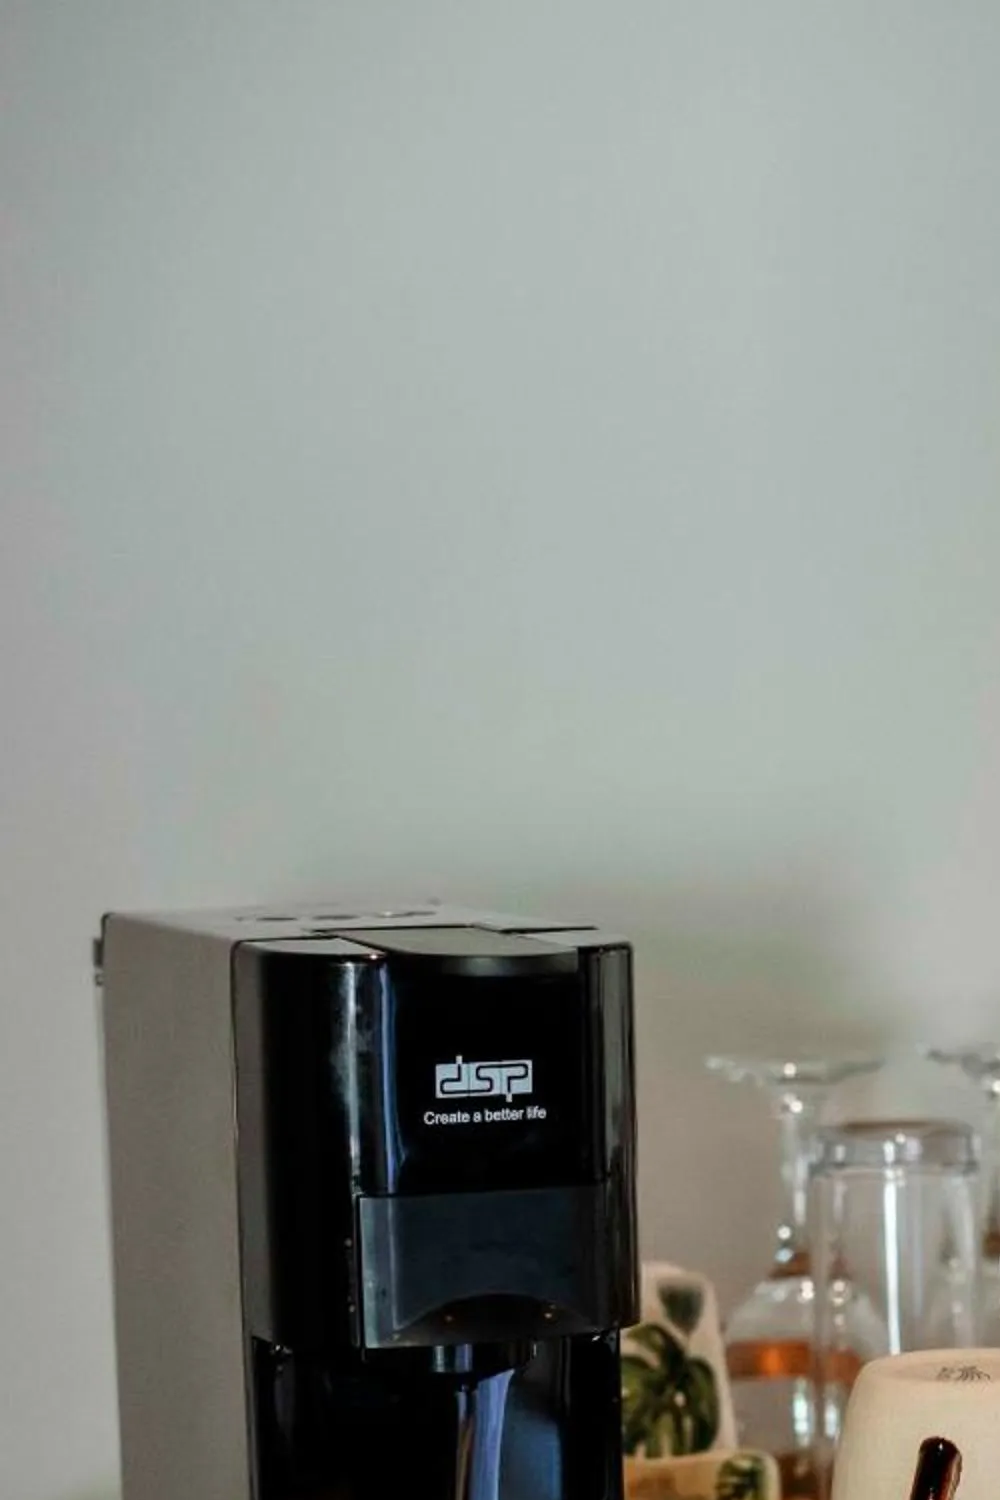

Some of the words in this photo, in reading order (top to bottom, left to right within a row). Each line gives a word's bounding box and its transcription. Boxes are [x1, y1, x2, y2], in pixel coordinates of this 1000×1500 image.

[435, 1055, 533, 1102] dsp
[423, 1111, 471, 1125] Create
[473, 1111, 482, 1123] a
[485, 1108, 524, 1122] better
[526, 1105, 547, 1120] life
